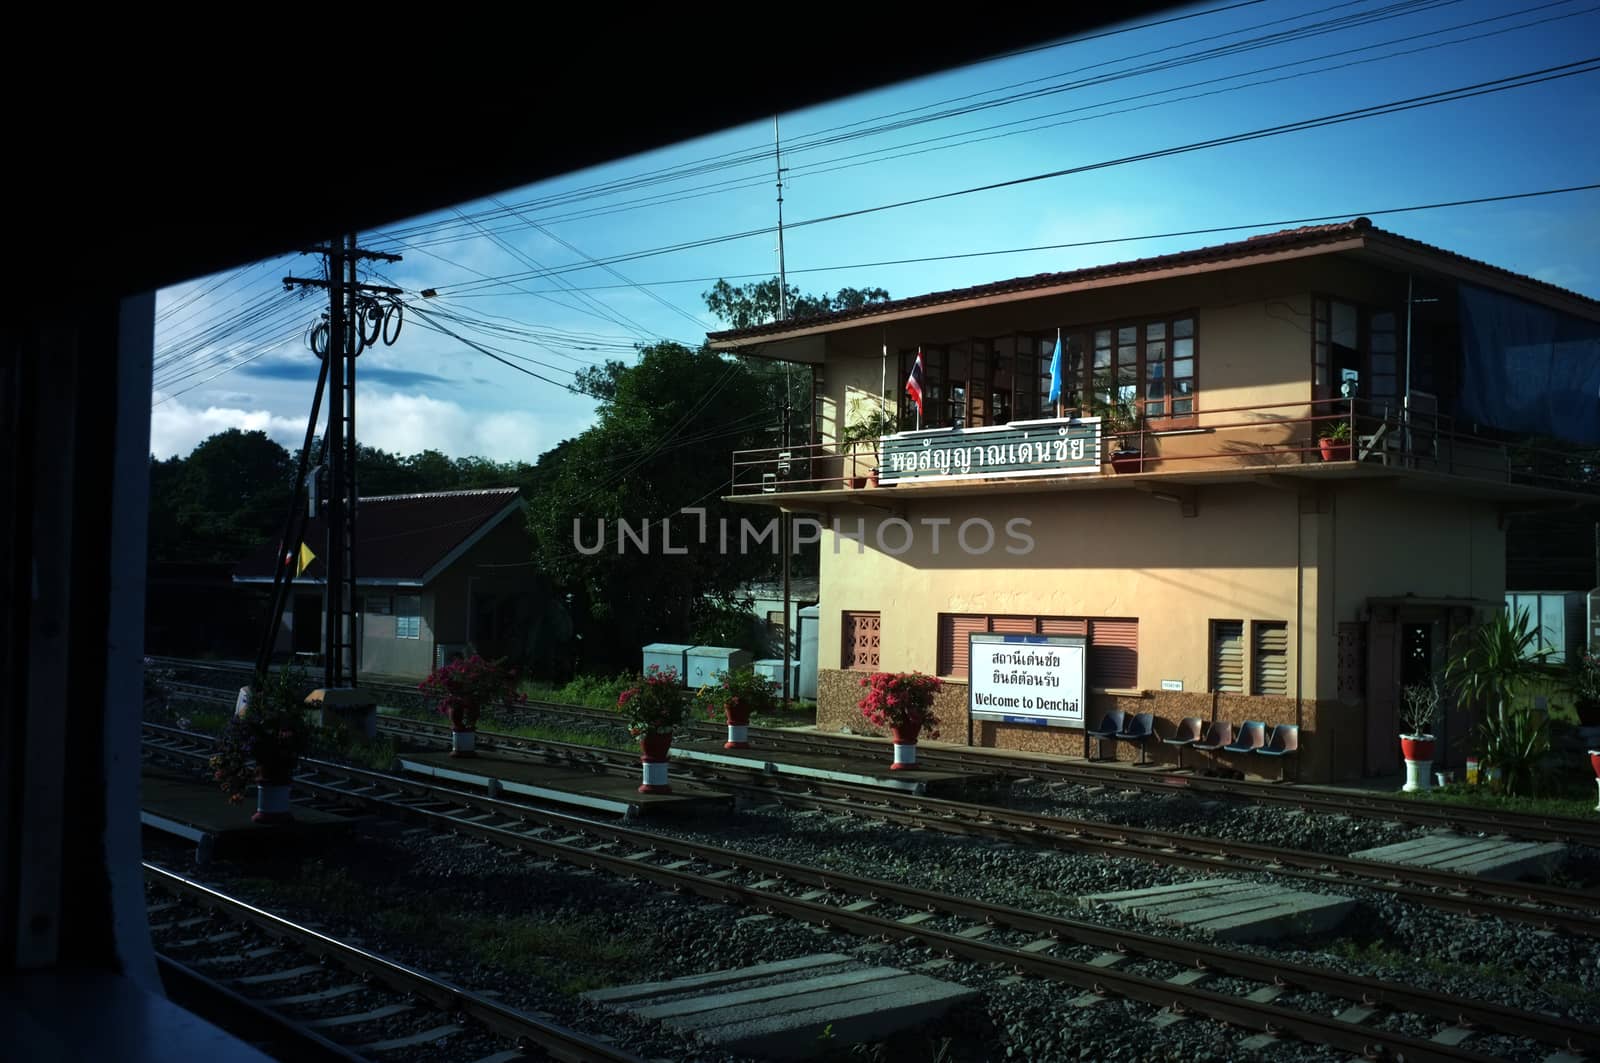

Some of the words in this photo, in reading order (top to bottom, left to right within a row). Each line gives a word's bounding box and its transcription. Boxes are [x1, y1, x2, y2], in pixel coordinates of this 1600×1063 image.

[890, 426, 1085, 474] หอสัญญาณเด่นชัย
[992, 650, 1060, 667] สถานีเด่นชัย
[993, 669, 1060, 687] ยินดีต้อนรับ
[975, 692, 1020, 708] Welcome
[1022, 696, 1034, 709] to
[1036, 697, 1079, 712] Denchai
